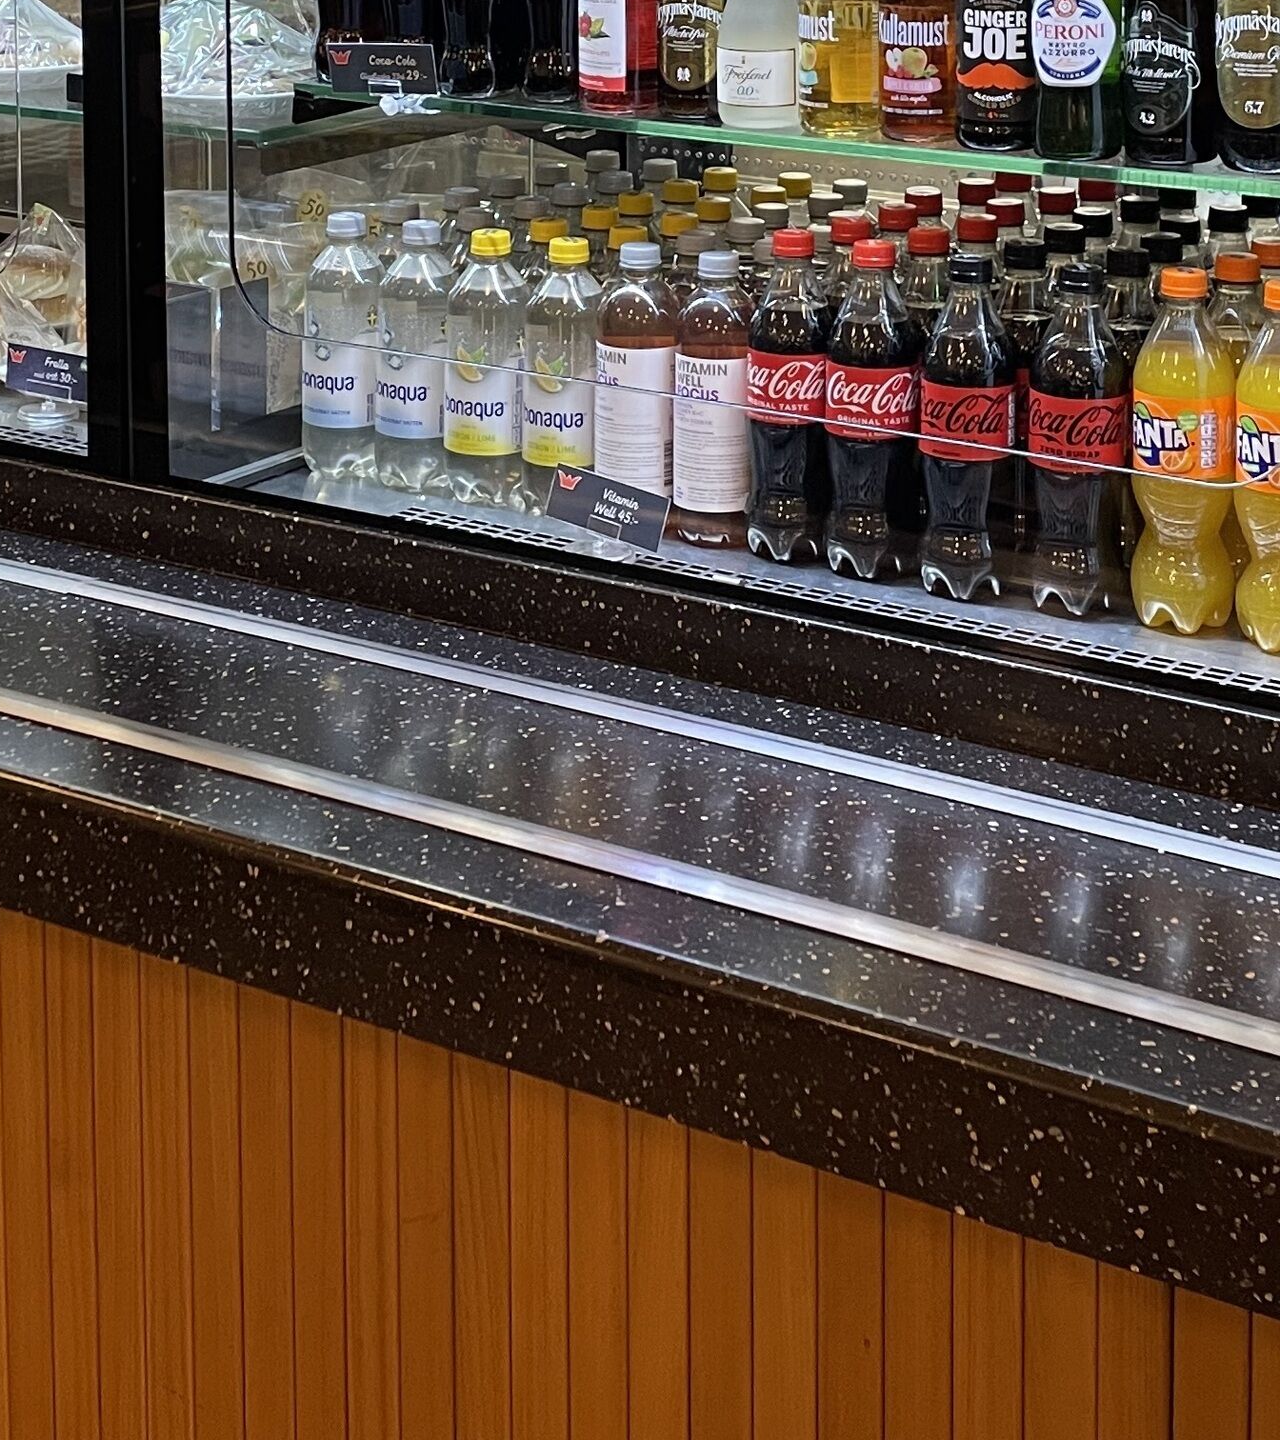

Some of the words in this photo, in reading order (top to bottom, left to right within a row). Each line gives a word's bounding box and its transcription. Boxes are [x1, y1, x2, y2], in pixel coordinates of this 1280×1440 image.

[963, 9, 1027, 27] GINGER
[1035, 22, 1105, 40] PERONI
[963, 28, 1027, 60] JOE
[369, 55, 417, 66] Coca-Cola
[678, 360, 728, 377] VITAMIN
[678, 373, 704, 388] WELL
[603, 488, 639, 510] Vitamin
[594, 502, 617, 519] Well
[618, 510, 639, 525] 45:-
